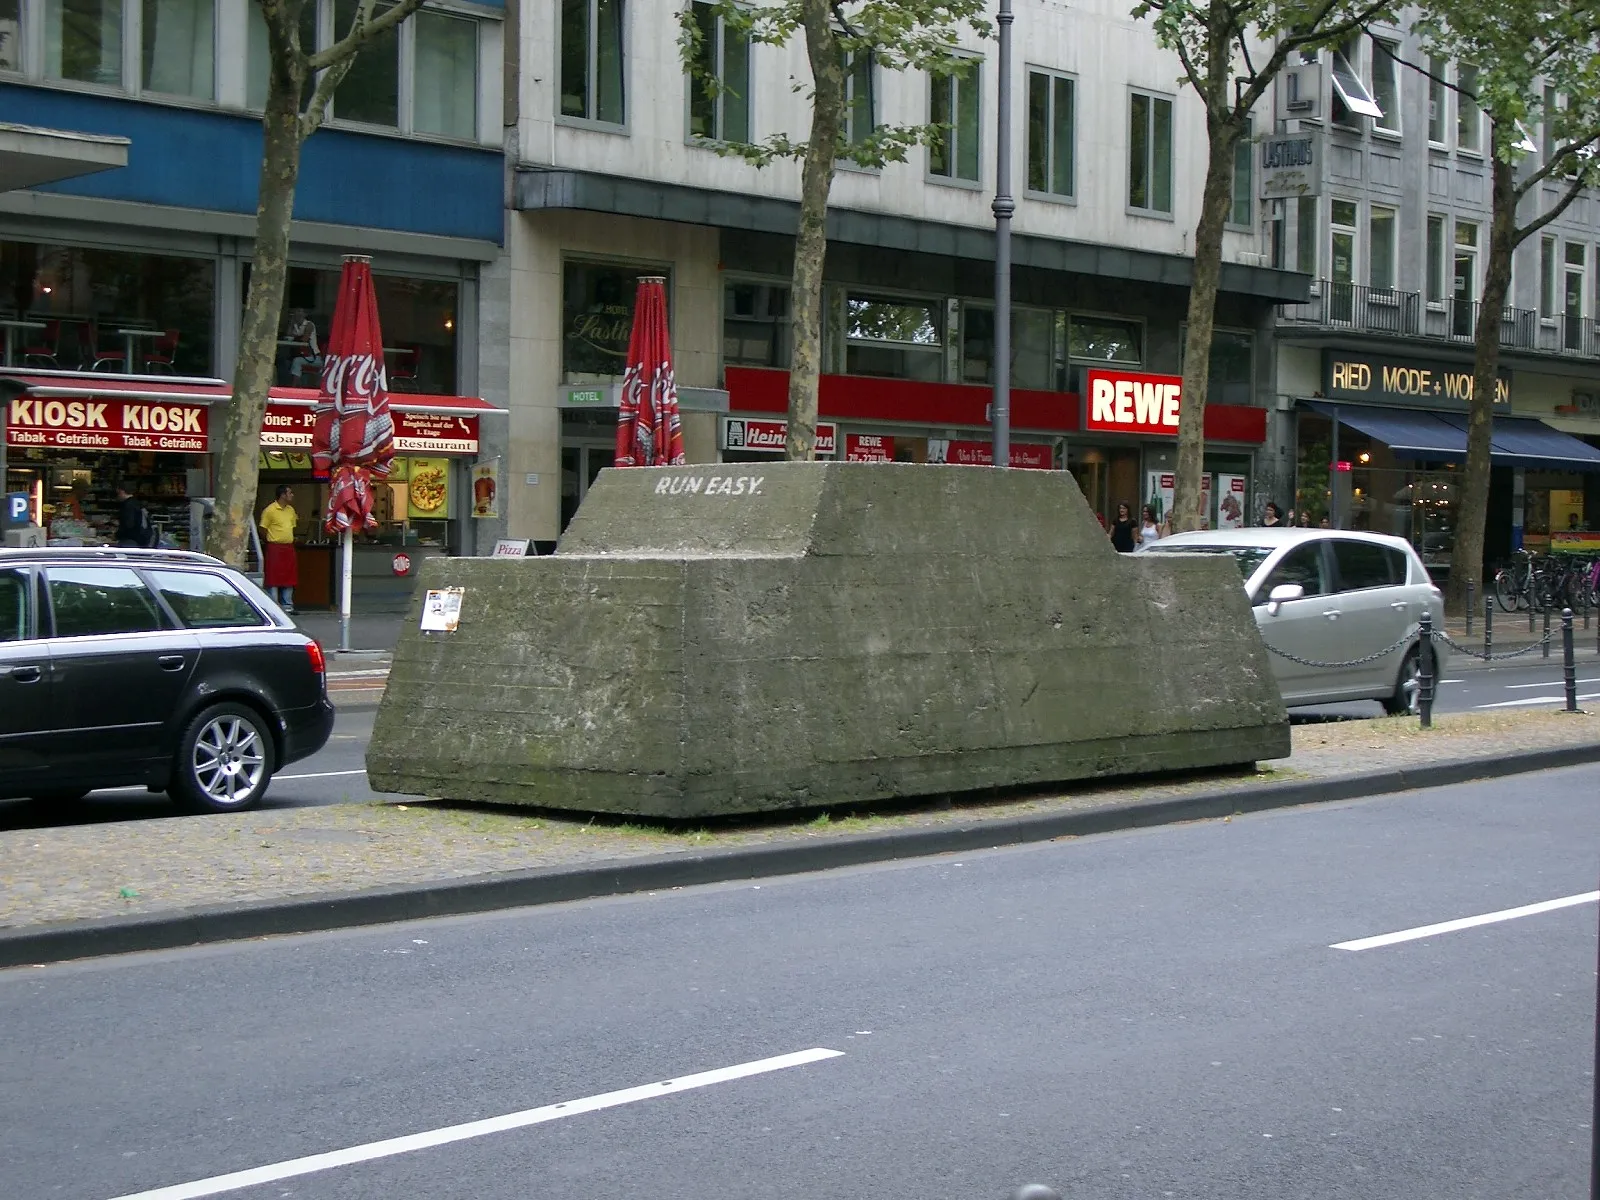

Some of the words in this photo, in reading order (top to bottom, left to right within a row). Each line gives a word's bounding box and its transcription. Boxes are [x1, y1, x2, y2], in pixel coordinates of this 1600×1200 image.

[1333, 361, 1371, 391] RIED
[573, 391, 600, 402] HOTEL
[1092, 378, 1181, 426] REWE
[10, 400, 108, 429] KIOSK
[122, 404, 202, 433] KIOSK
[264, 412, 294, 426] öner
[11, 430, 46, 443] Tabak
[56, 432, 110, 446] Getränke
[122, 434, 152, 448] Tabak
[159, 437, 202, 450] Getränke
[398, 438, 471, 451] Restaurant
[858, 435, 882, 447] REWE
[654, 475, 704, 495] RUN
[704, 475, 765, 495] EASY.
[12, 498, 27, 517] P
[498, 543, 522, 555] Pizza
